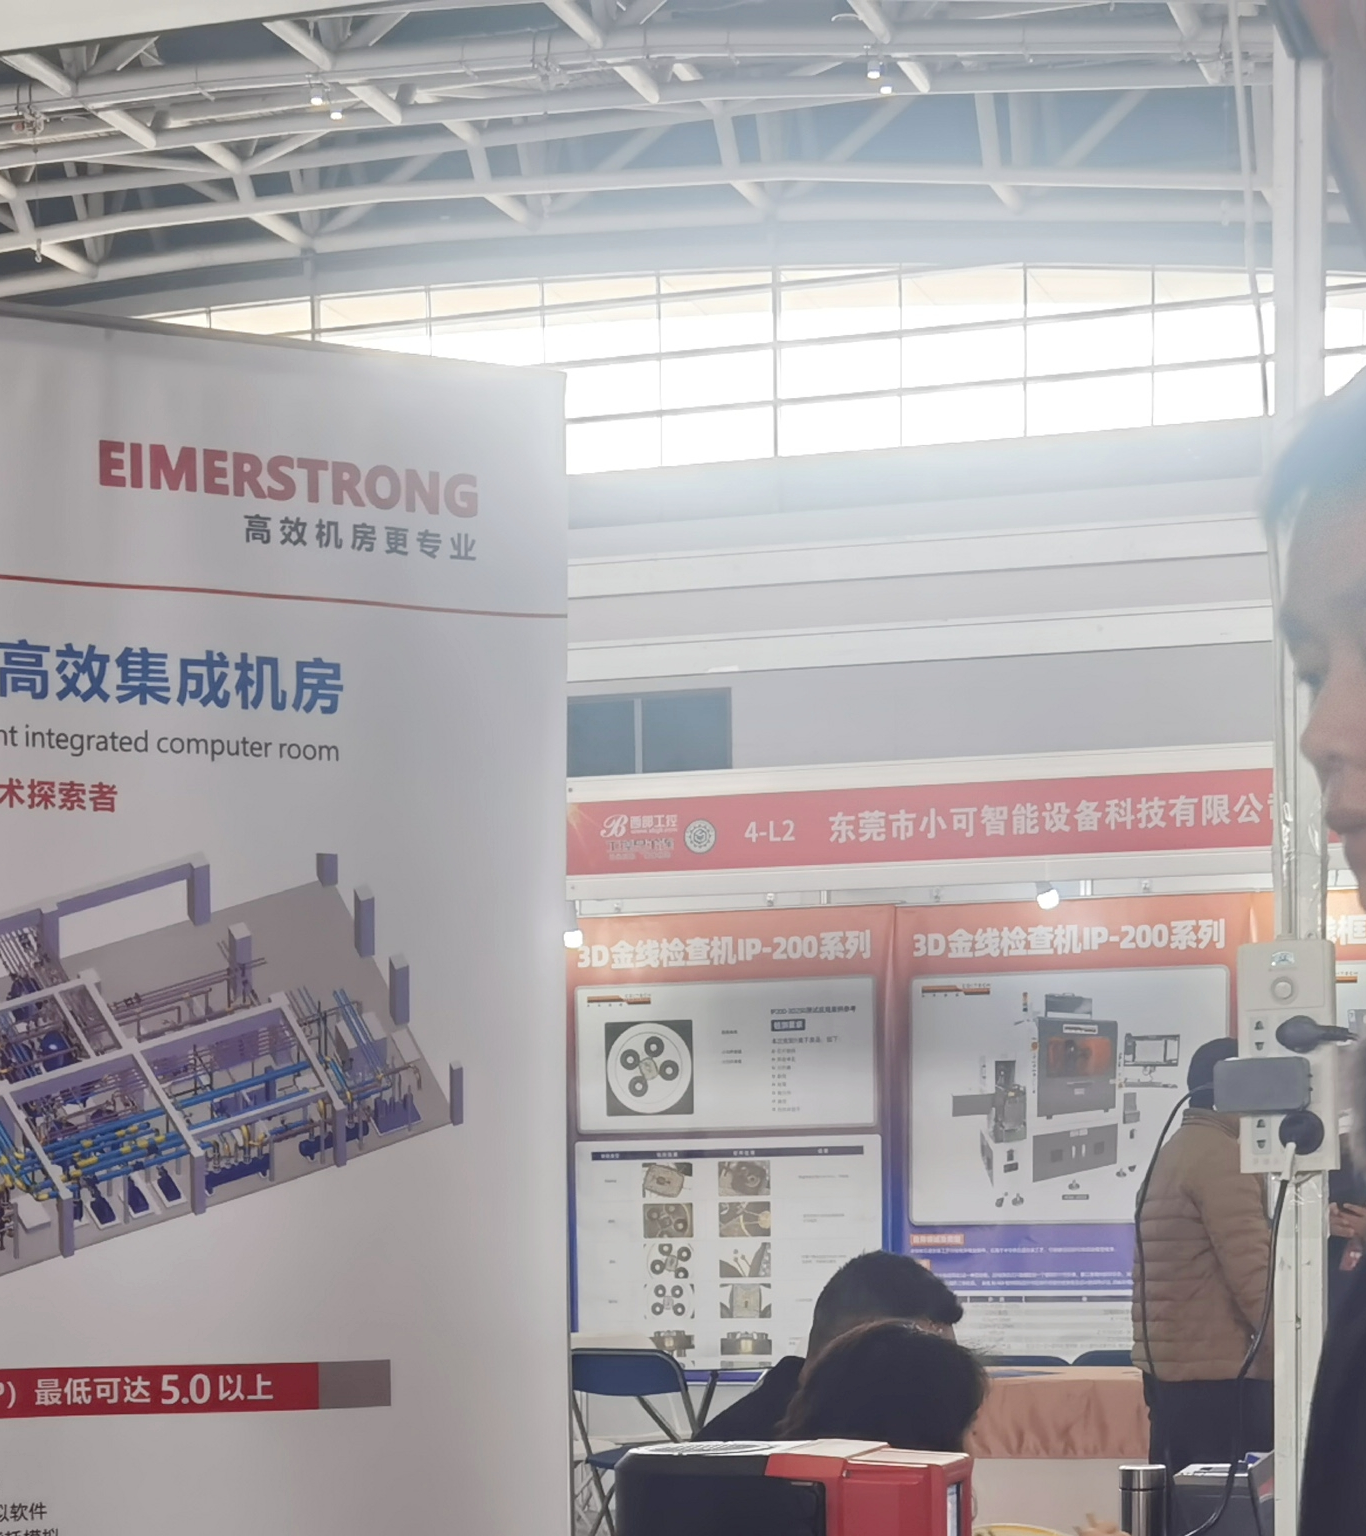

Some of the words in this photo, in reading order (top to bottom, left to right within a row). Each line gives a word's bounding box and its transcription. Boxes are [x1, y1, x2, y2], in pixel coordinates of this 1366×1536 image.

[98, 439, 480, 519] EIMERSTRONG
[243, 513, 478, 562] 高效机房更专业
[24, 723, 150, 756] integrated
[156, 732, 272, 762] computer
[278, 740, 340, 762] room
[744, 819, 796, 843] 4-L2
[828, 793, 1274, 843] 东莞市小可智能设备科技有限公
[577, 929, 872, 969] 3D金线检查机IP-200系列
[912, 918, 1226, 960] 3D金线检查机IP-200系列
